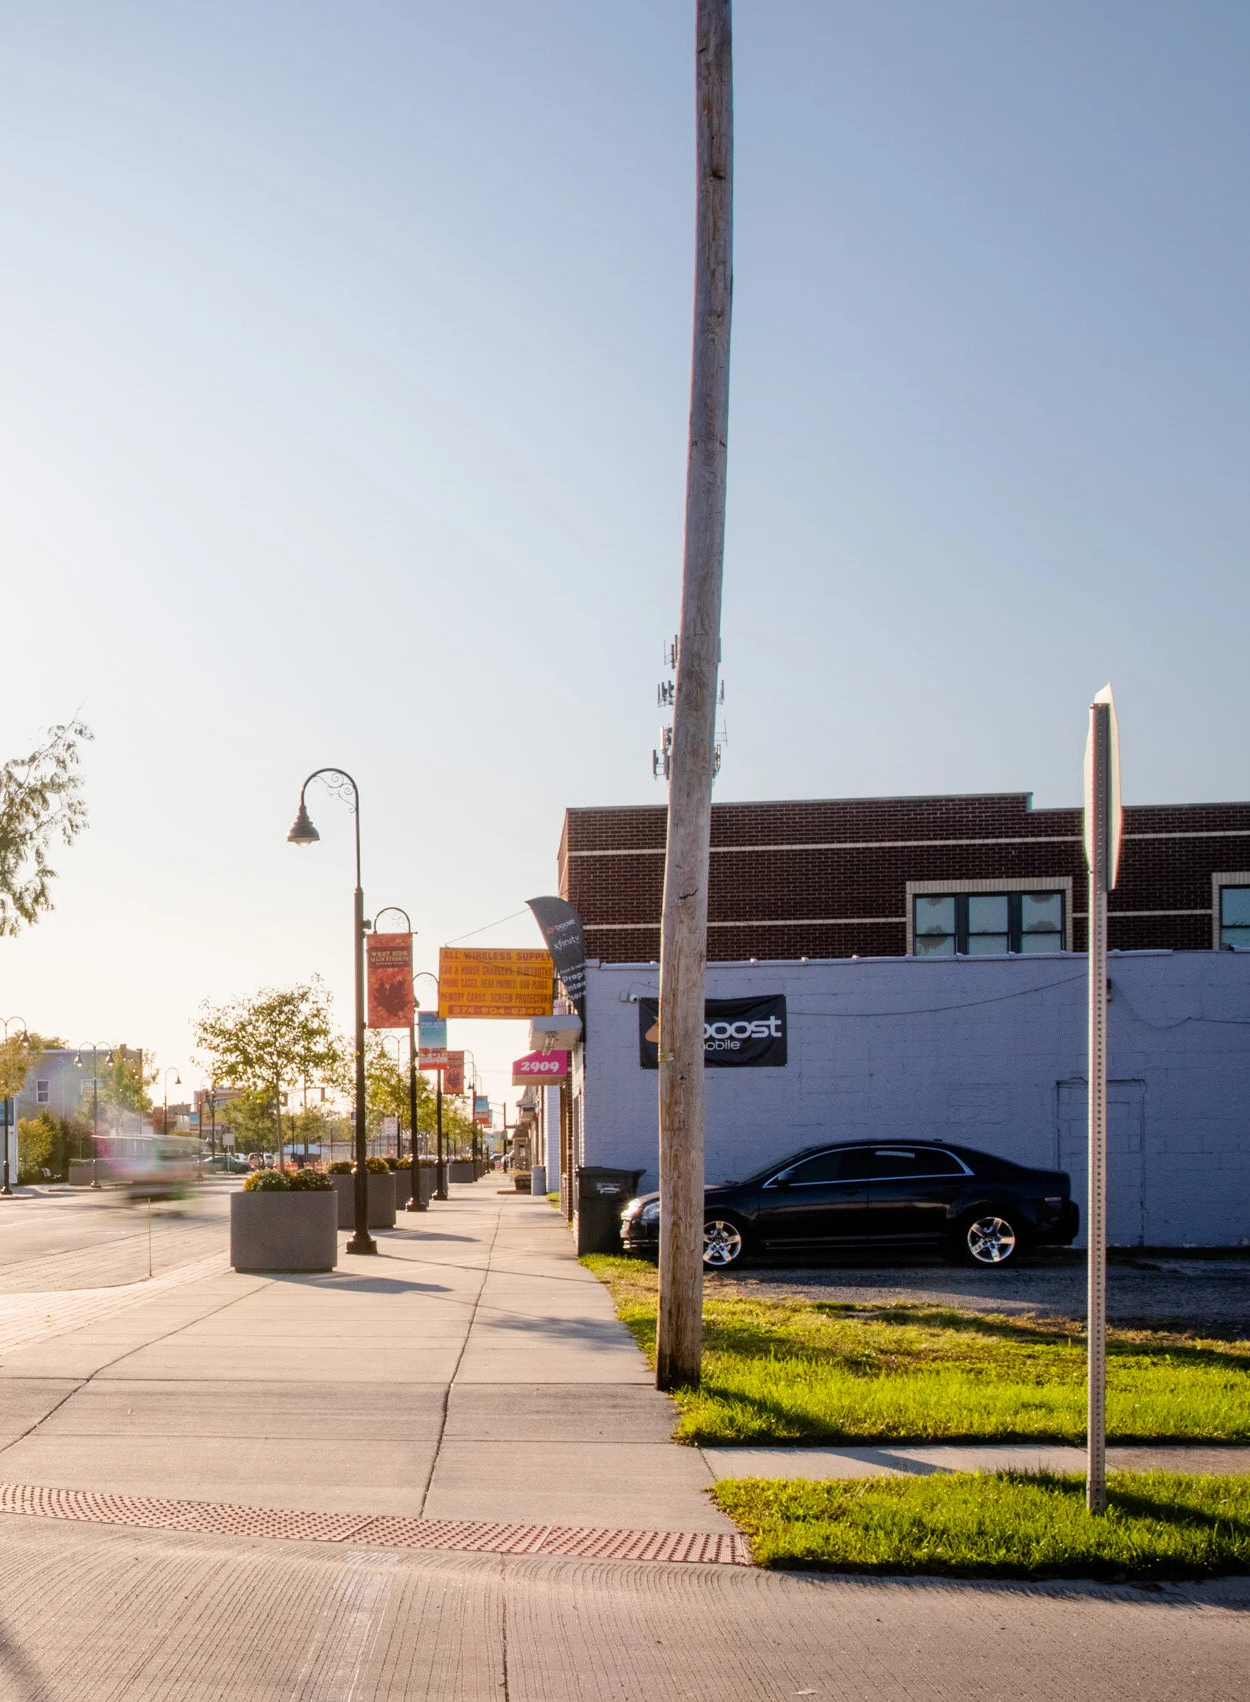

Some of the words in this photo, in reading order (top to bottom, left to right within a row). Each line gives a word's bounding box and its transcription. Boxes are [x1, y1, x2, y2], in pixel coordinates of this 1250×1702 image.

[443, 950, 461, 960] ALL
[464, 951, 513, 961] WIRELESS
[516, 951, 551, 961] SUPPLY
[461, 965, 480, 976] HOUSE
[703, 1040, 741, 1050] obile
[520, 1061, 560, 1072] 2909
